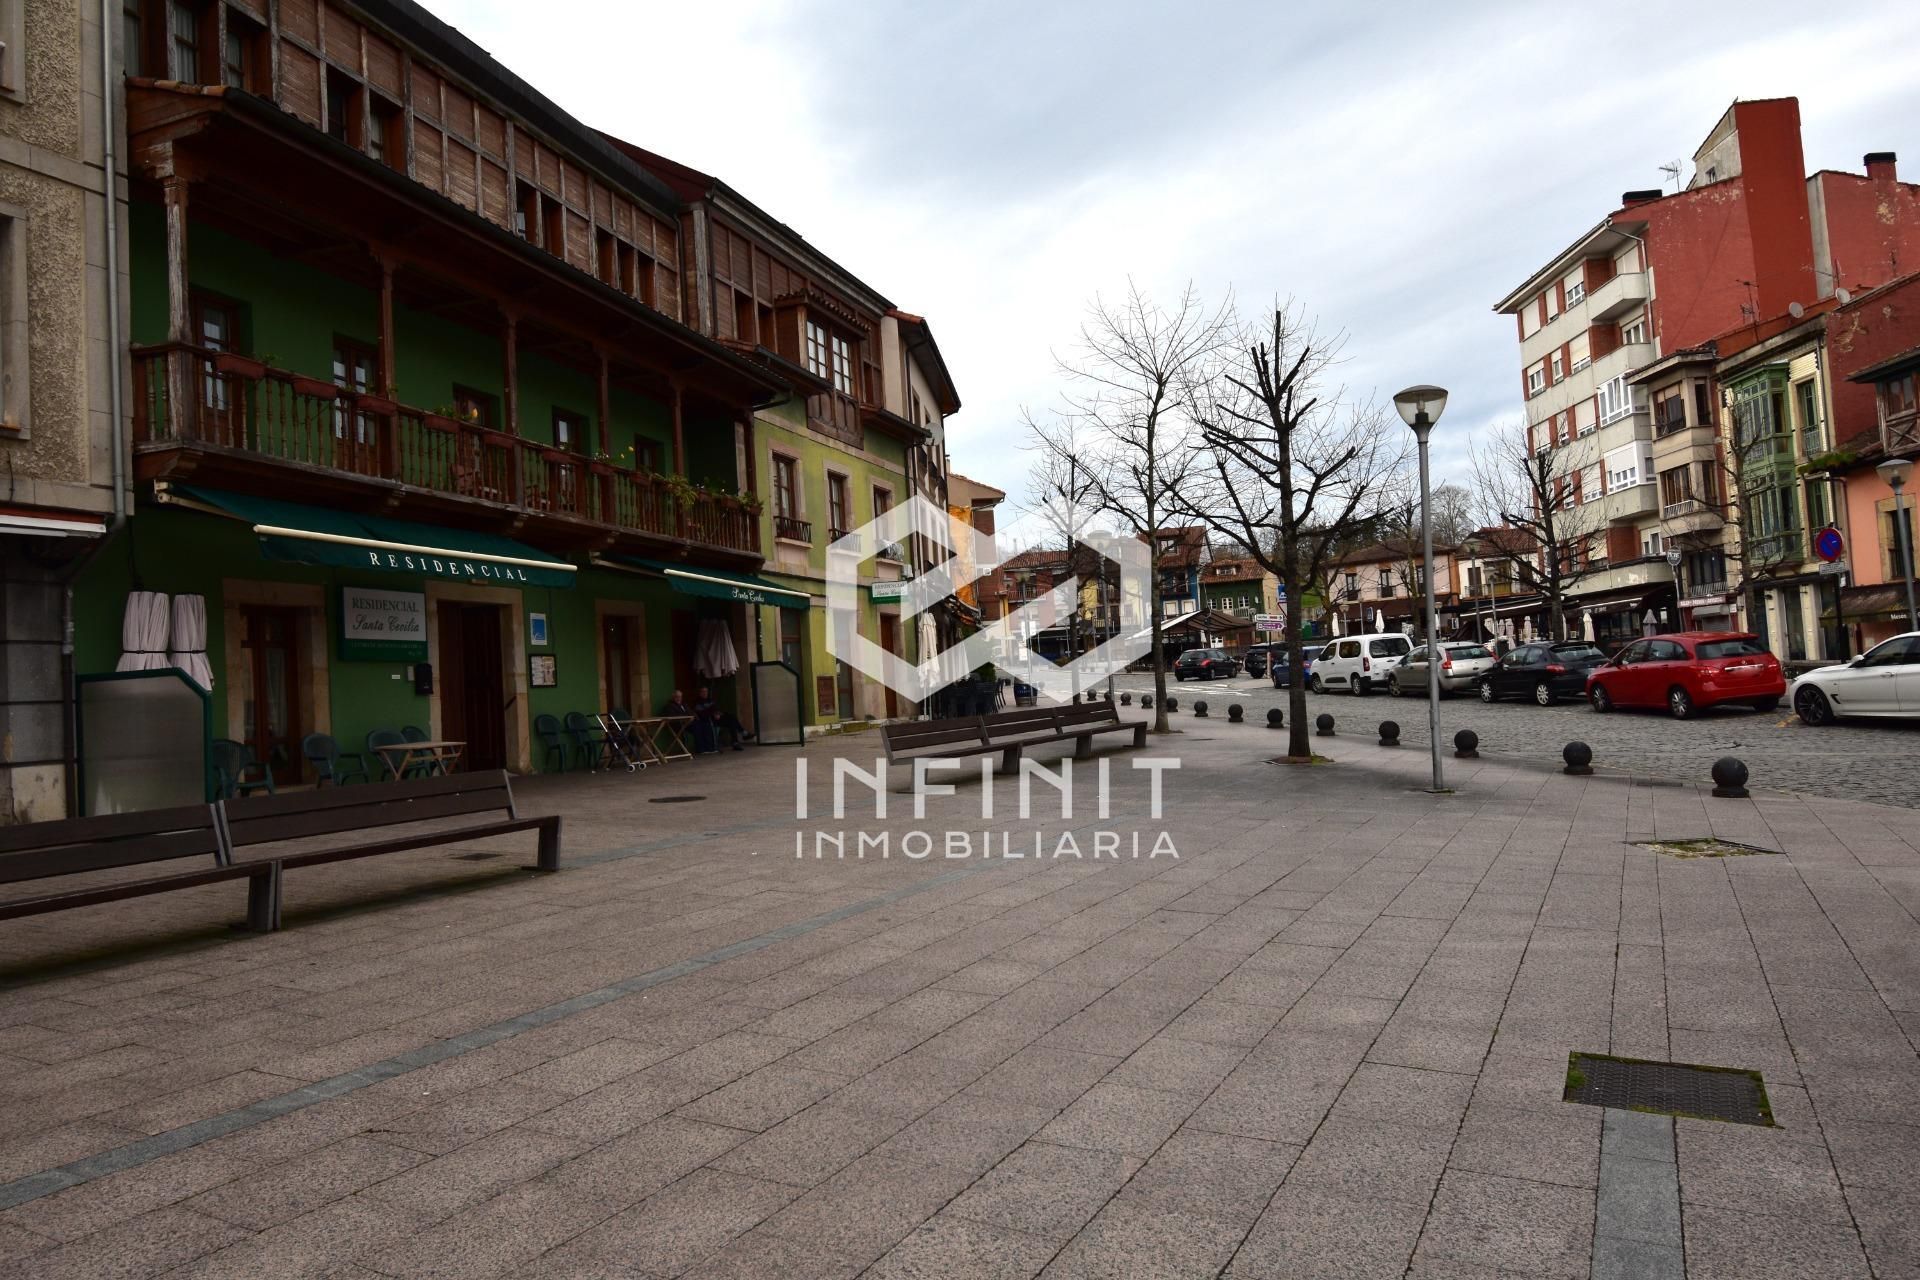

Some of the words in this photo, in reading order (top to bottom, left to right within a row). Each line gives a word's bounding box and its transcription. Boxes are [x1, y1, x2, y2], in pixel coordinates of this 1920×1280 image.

[369, 551, 528, 581] RESIDENCIAL
[352, 597, 419, 613] RESIDENCIAL
[352, 614, 384, 631] Santa
[387, 615, 420, 633] Cecilia
